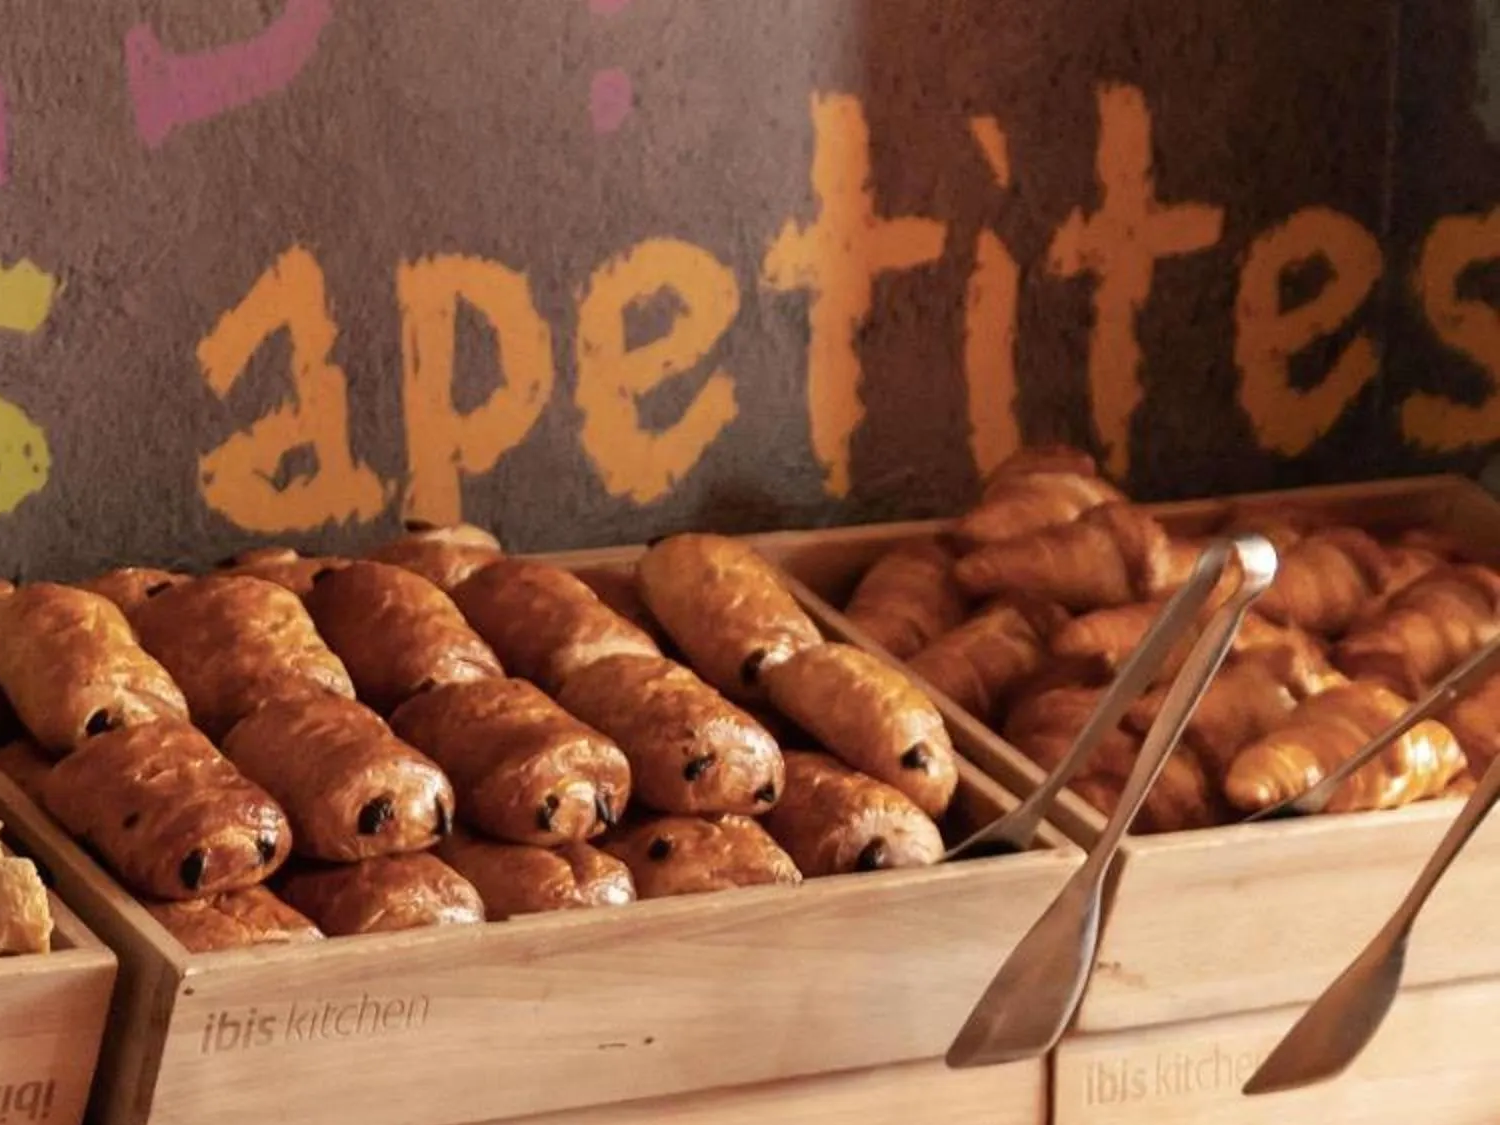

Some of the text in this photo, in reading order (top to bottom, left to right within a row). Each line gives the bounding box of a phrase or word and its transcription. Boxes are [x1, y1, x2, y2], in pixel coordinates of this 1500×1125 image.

[201, 993, 430, 1054] ibis kitchen
[1155, 1041, 1263, 1097] kitche
